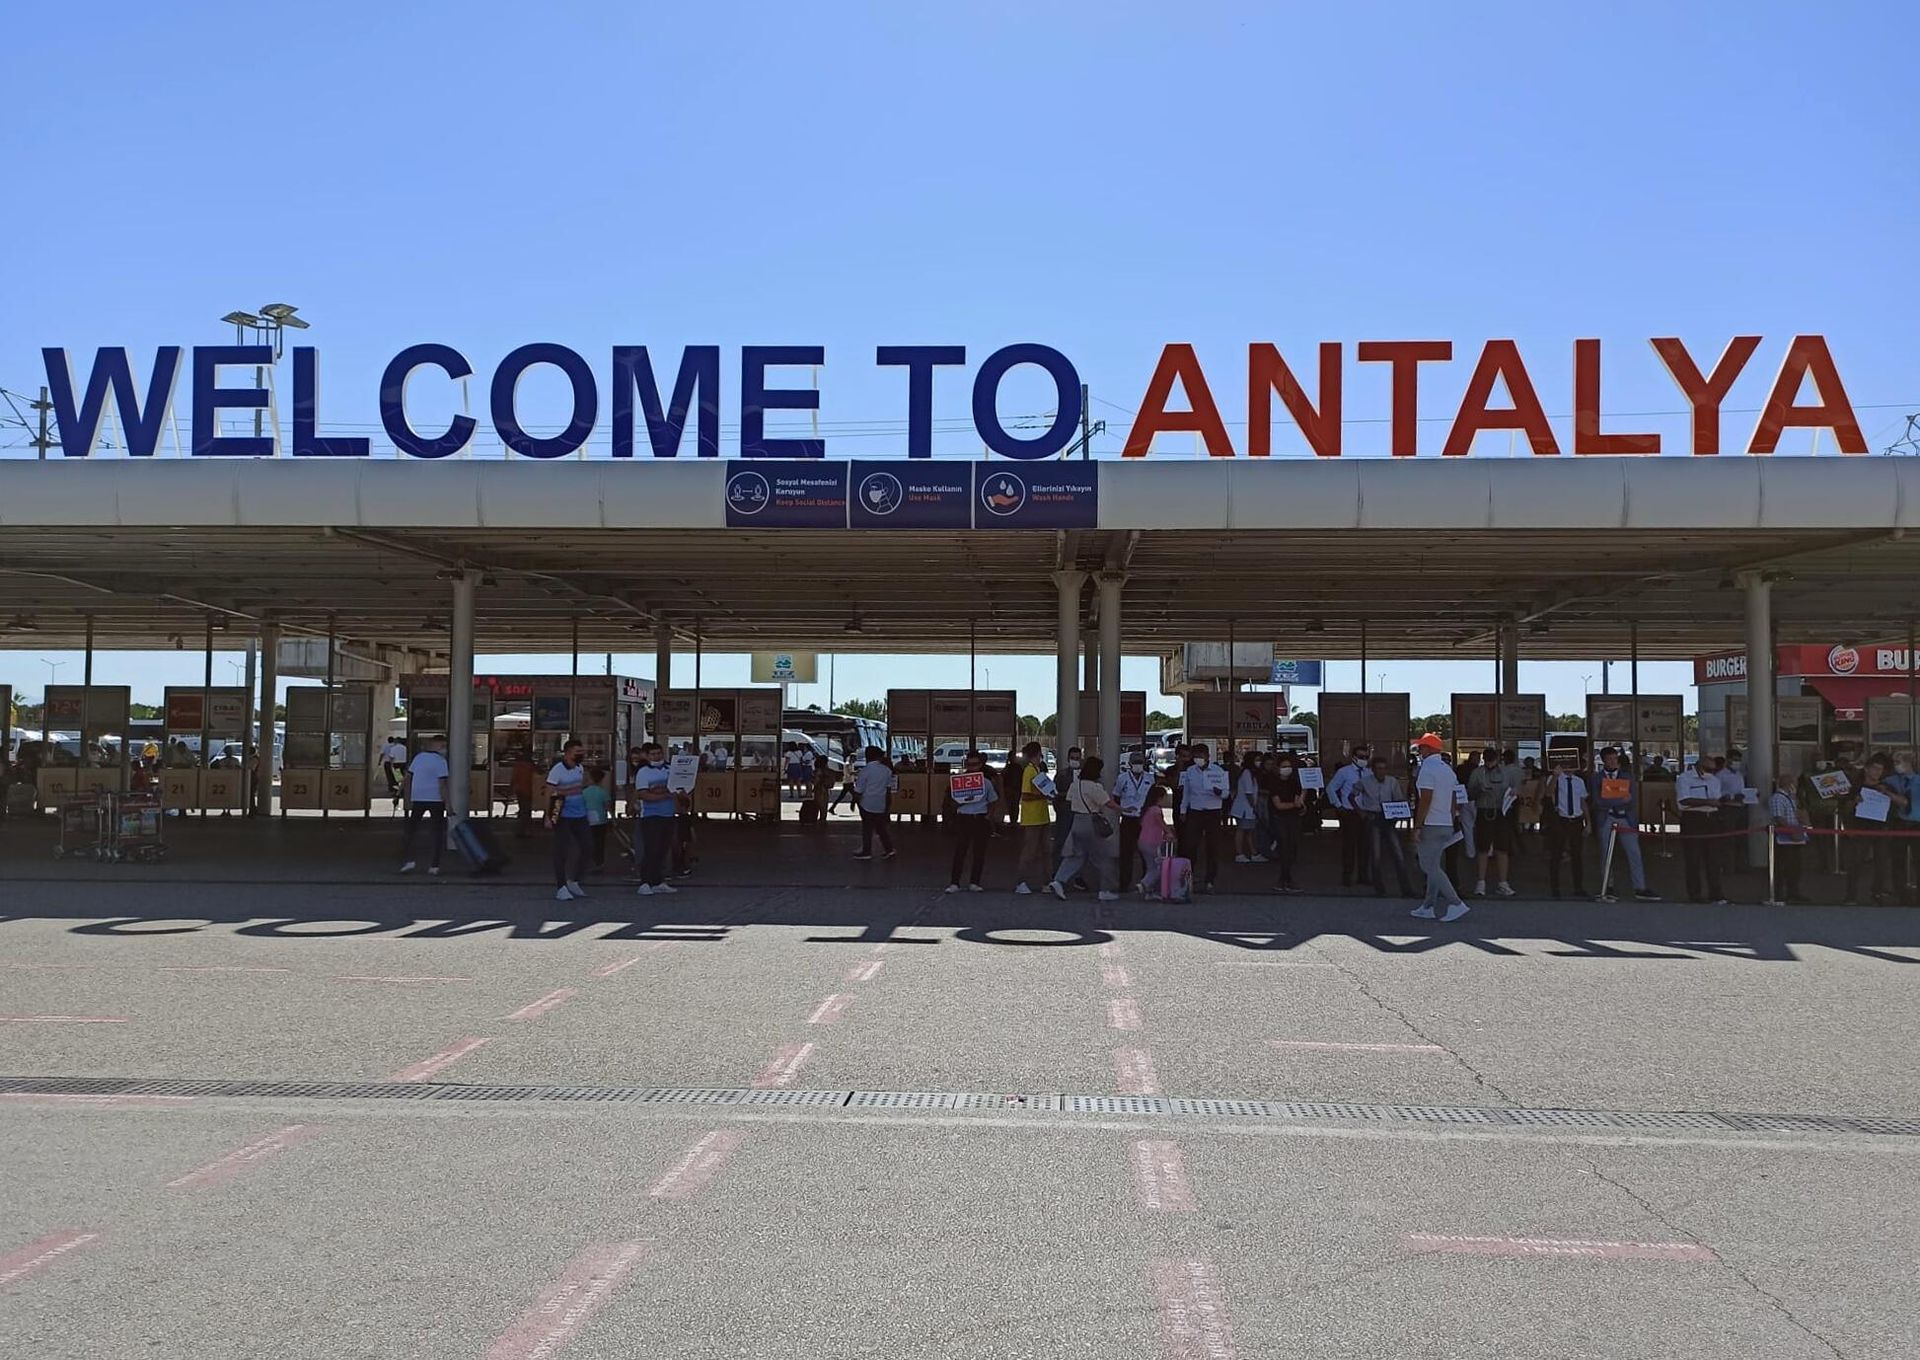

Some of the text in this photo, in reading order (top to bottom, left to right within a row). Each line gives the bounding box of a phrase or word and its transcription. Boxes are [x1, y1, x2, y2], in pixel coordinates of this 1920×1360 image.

[43, 335, 1869, 460] WELCOME TO ANTALYA
[776, 479, 799, 487] Sosyal
[923, 494, 942, 502] Mask
[1706, 655, 1747, 678] BURGER
[212, 785, 226, 795] 22
[294, 784, 307, 795] 23
[335, 785, 349, 796] 24
[707, 788, 721, 798] 30
